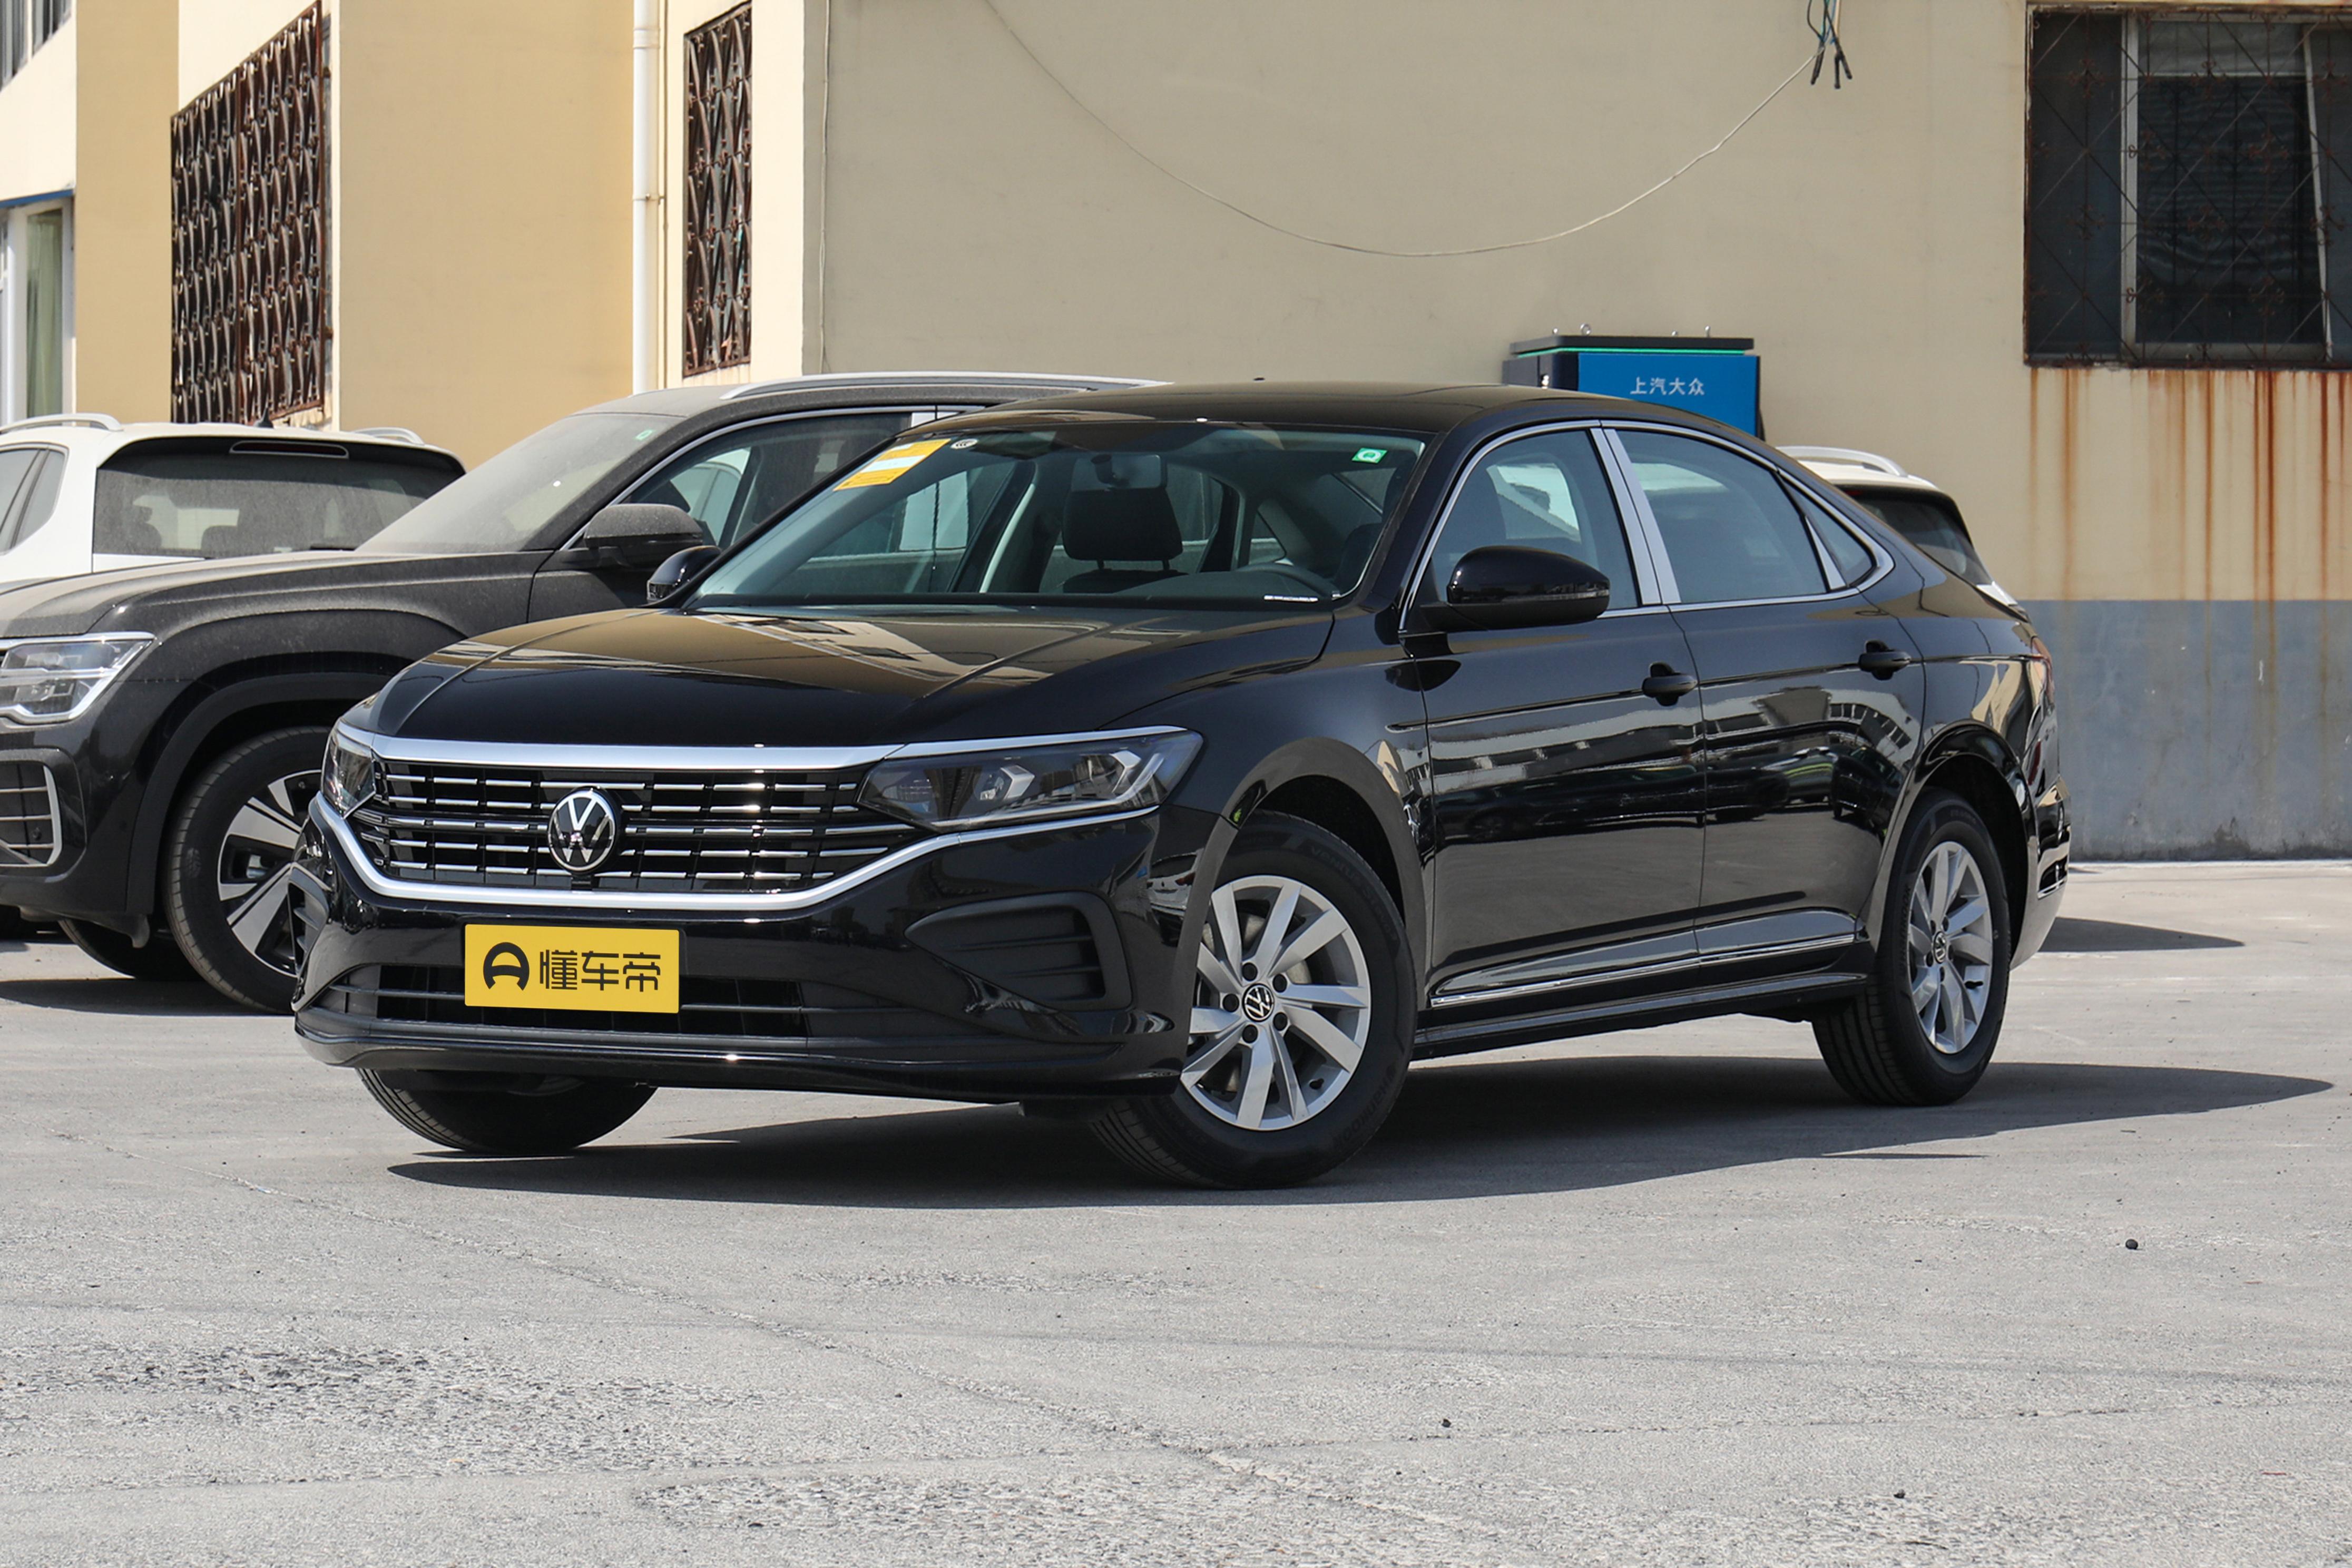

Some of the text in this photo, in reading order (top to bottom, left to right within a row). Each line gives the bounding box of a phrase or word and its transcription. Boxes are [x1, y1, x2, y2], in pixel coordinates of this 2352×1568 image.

[1630, 376, 1705, 395] 上汽大众
[540, 949, 661, 992] 懂车帝
